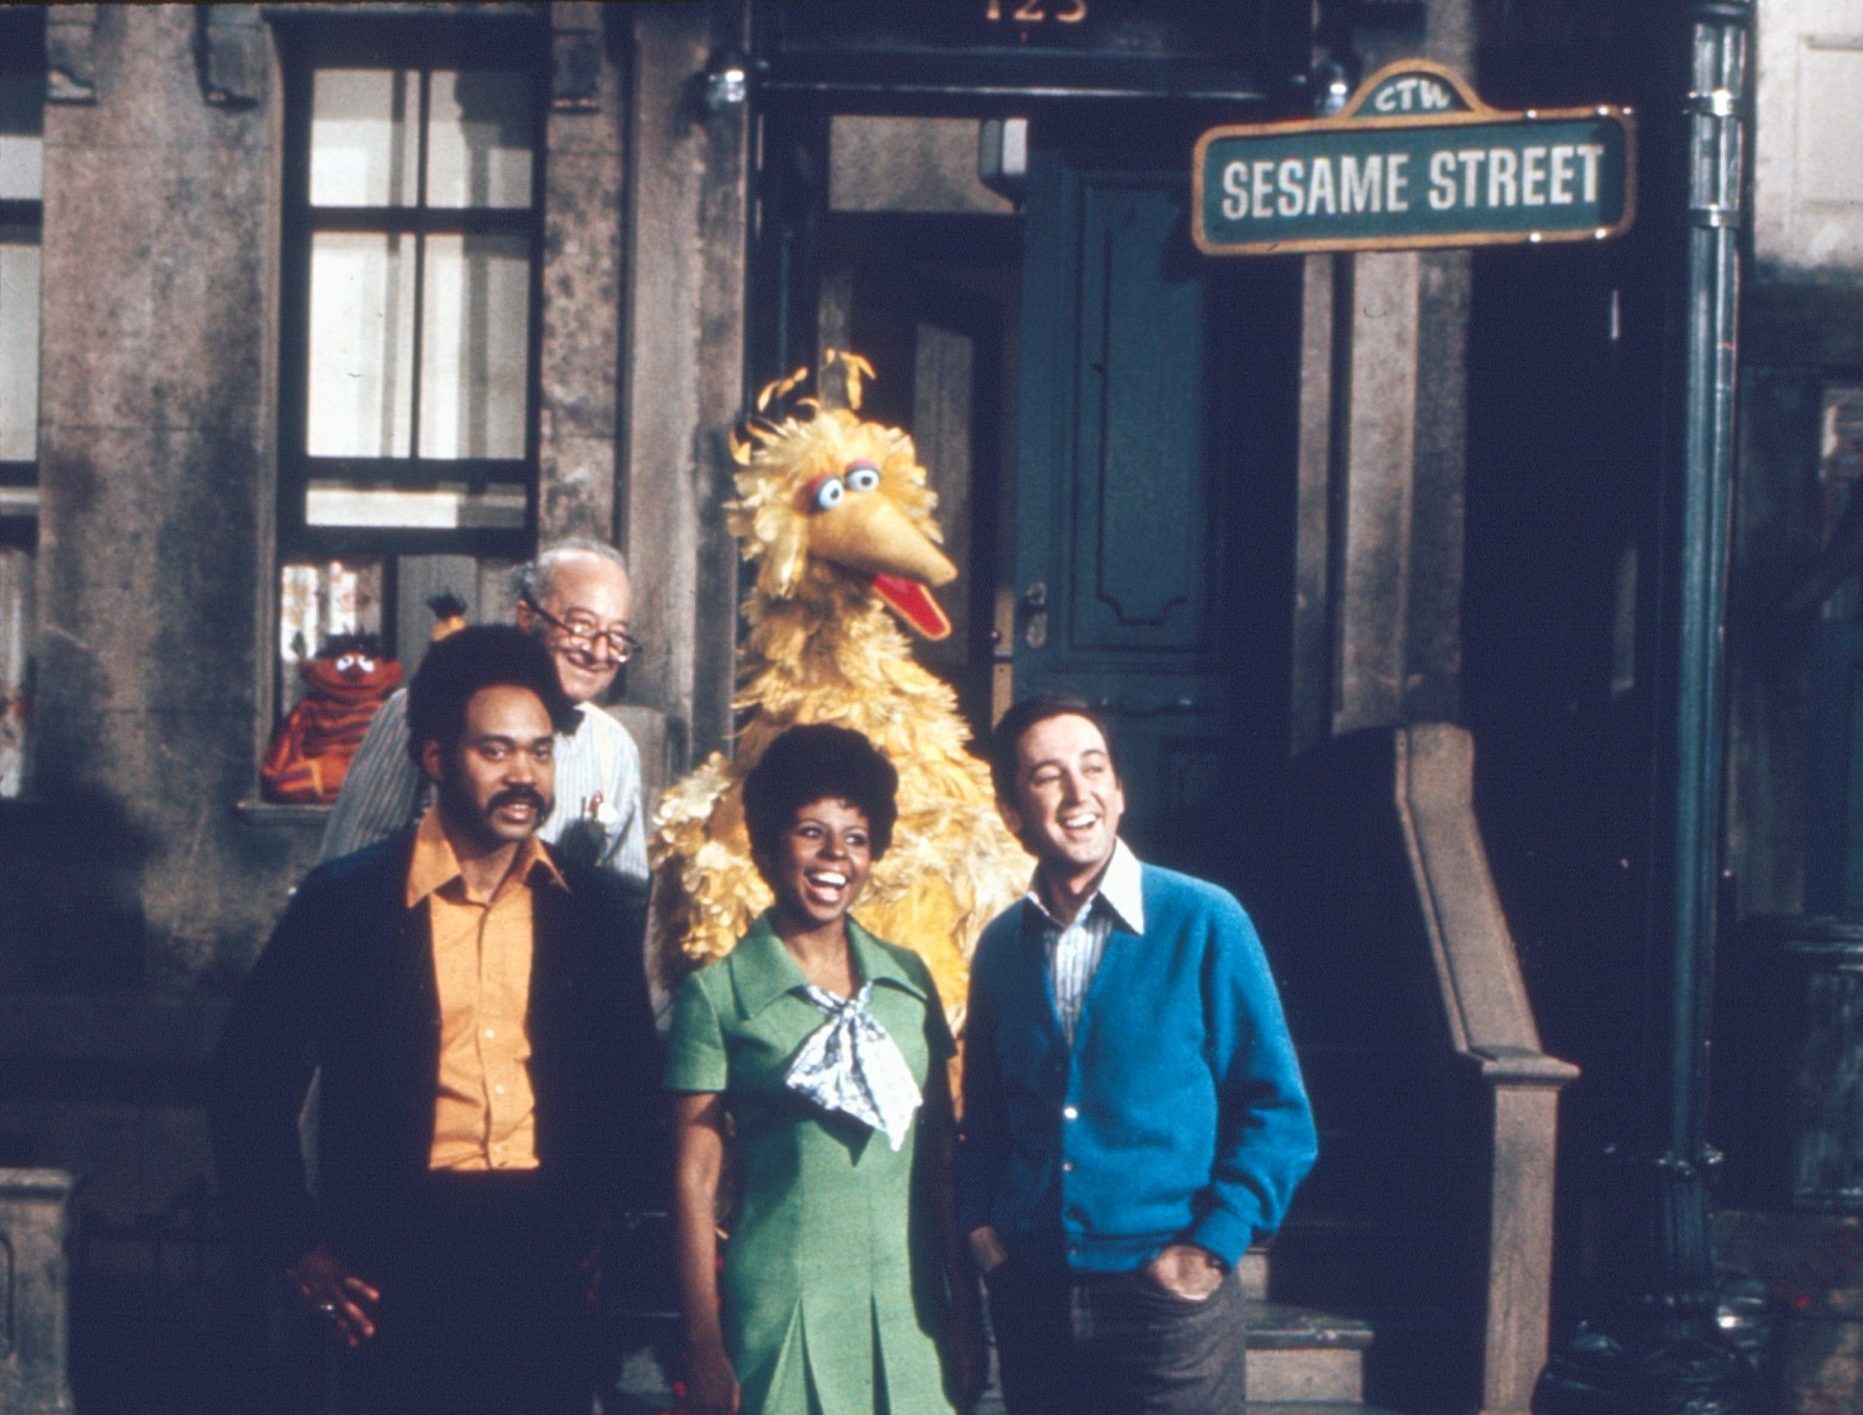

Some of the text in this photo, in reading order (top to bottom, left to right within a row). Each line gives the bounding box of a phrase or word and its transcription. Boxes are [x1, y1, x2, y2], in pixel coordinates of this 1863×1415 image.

[1374, 78, 1451, 111] CTW
[1222, 144, 1605, 220] SESAME STREET
